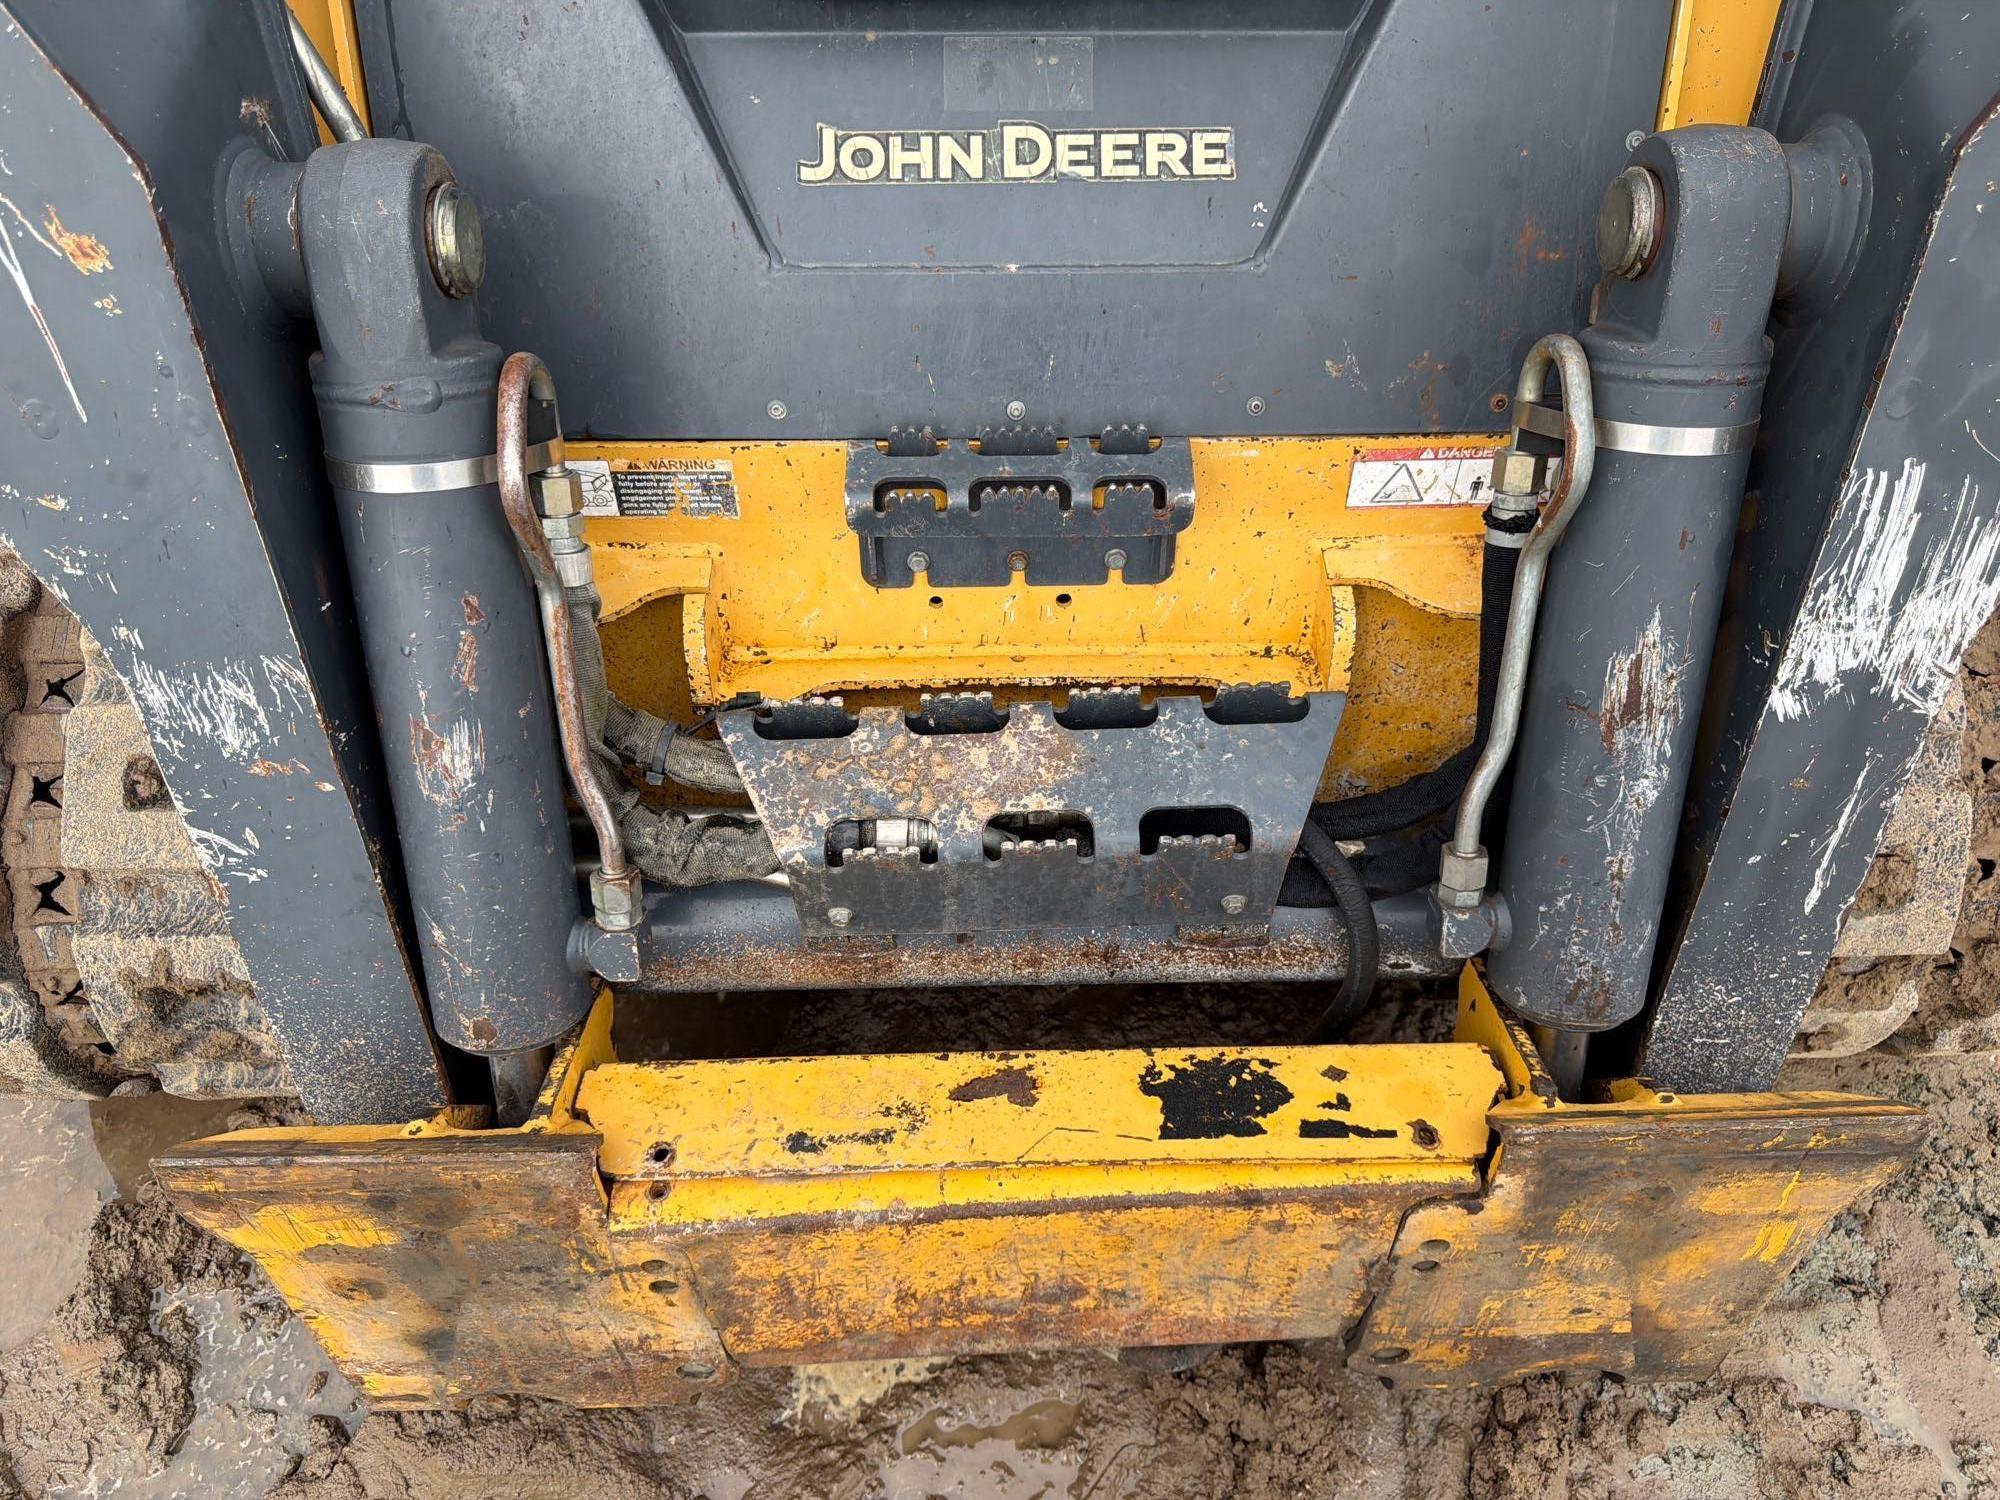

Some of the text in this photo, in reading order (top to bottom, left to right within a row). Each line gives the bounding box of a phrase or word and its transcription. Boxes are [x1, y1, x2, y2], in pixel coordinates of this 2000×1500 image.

[799, 125, 1232, 182] JOHN DEERE
[644, 459, 716, 470] WARNING
